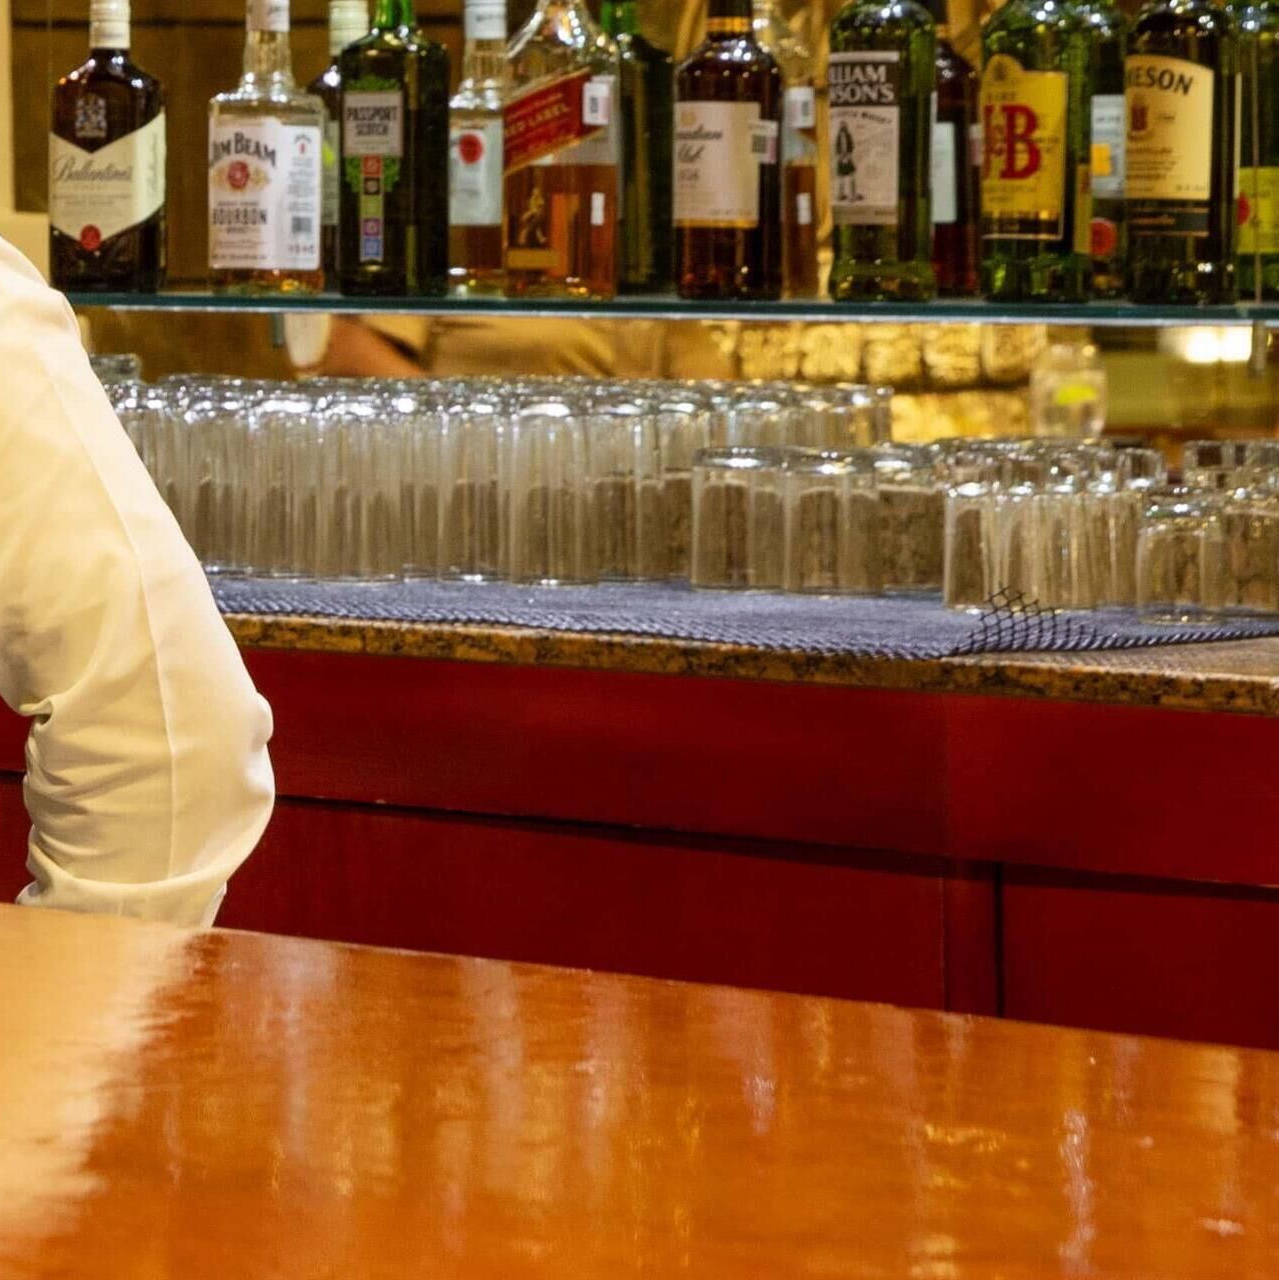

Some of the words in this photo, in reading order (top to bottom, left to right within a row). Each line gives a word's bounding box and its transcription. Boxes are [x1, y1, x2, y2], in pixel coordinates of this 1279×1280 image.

[346, 105, 398, 122] PASSPORT
[355, 122, 389, 137] SCOTCH
[233, 131, 277, 169] BEAM
[212, 207, 268, 225] BOURBON
